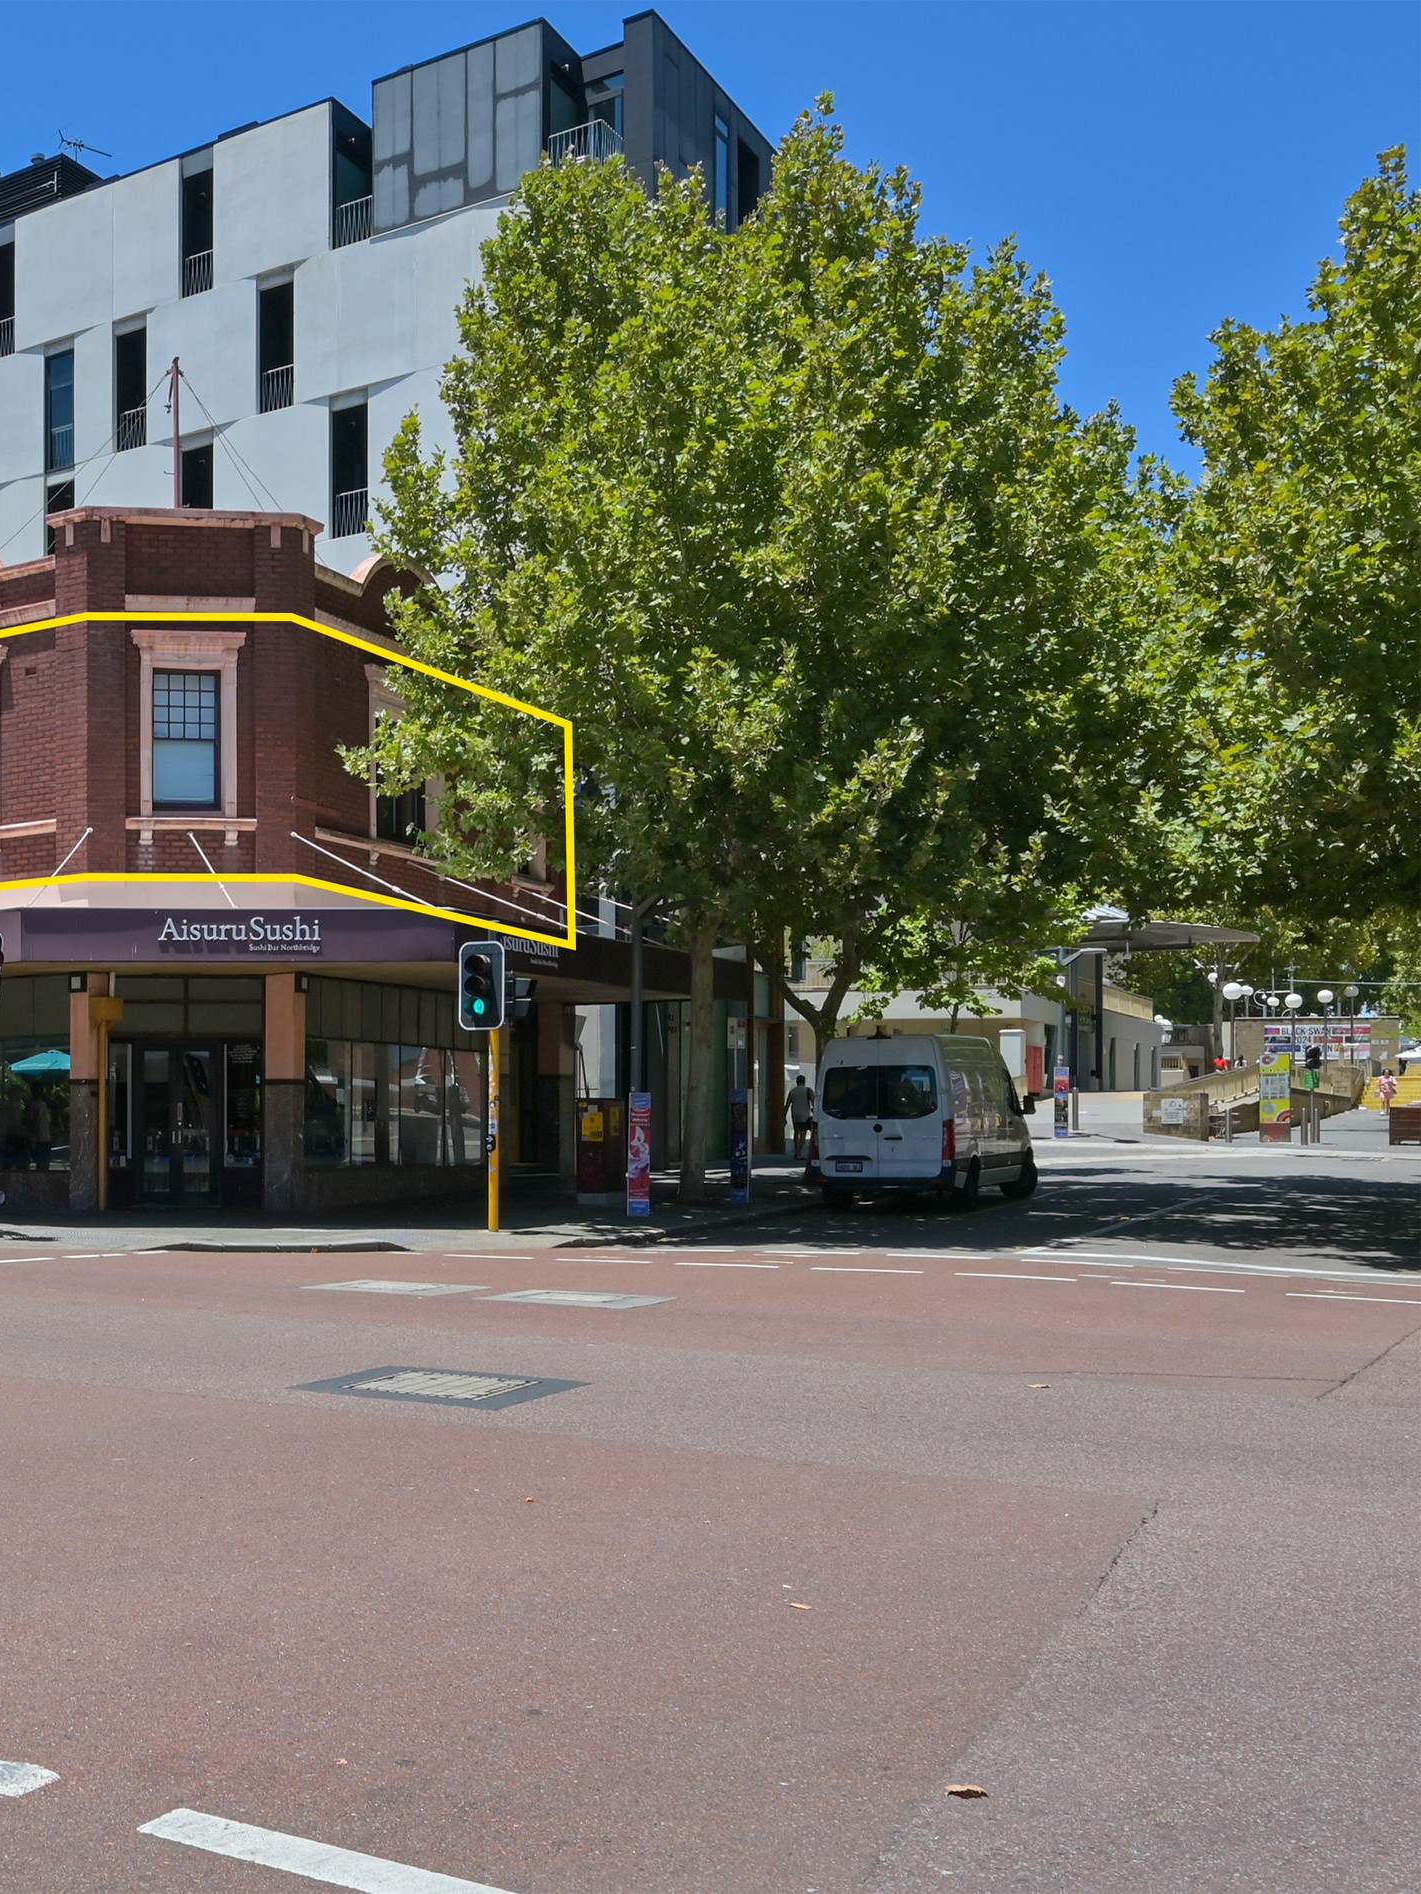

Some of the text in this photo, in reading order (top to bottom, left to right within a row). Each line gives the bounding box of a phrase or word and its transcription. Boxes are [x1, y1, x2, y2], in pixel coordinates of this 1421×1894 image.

[249, 943, 320, 953] Sushi Bar Northbridge
